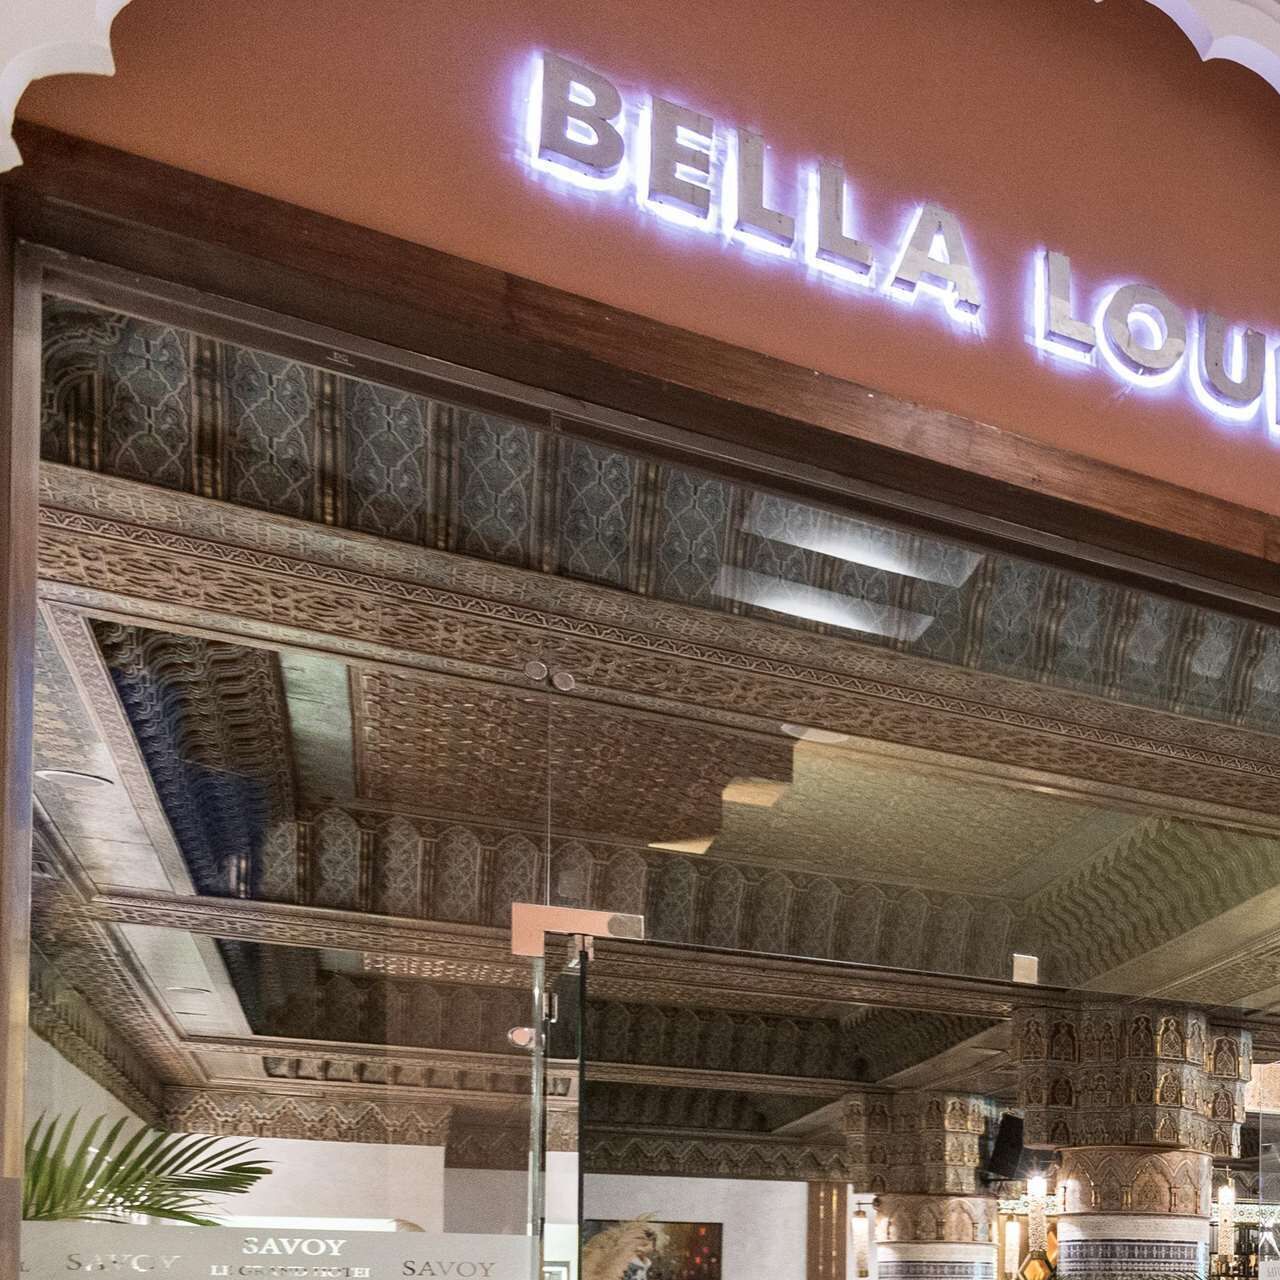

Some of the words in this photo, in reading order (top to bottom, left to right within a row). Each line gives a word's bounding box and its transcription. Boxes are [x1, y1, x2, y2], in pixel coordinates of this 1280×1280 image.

[533, 50, 983, 318] BELLA
[242, 1236, 347, 1257] SAVOY
[402, 1259, 496, 1278] SAVOY
